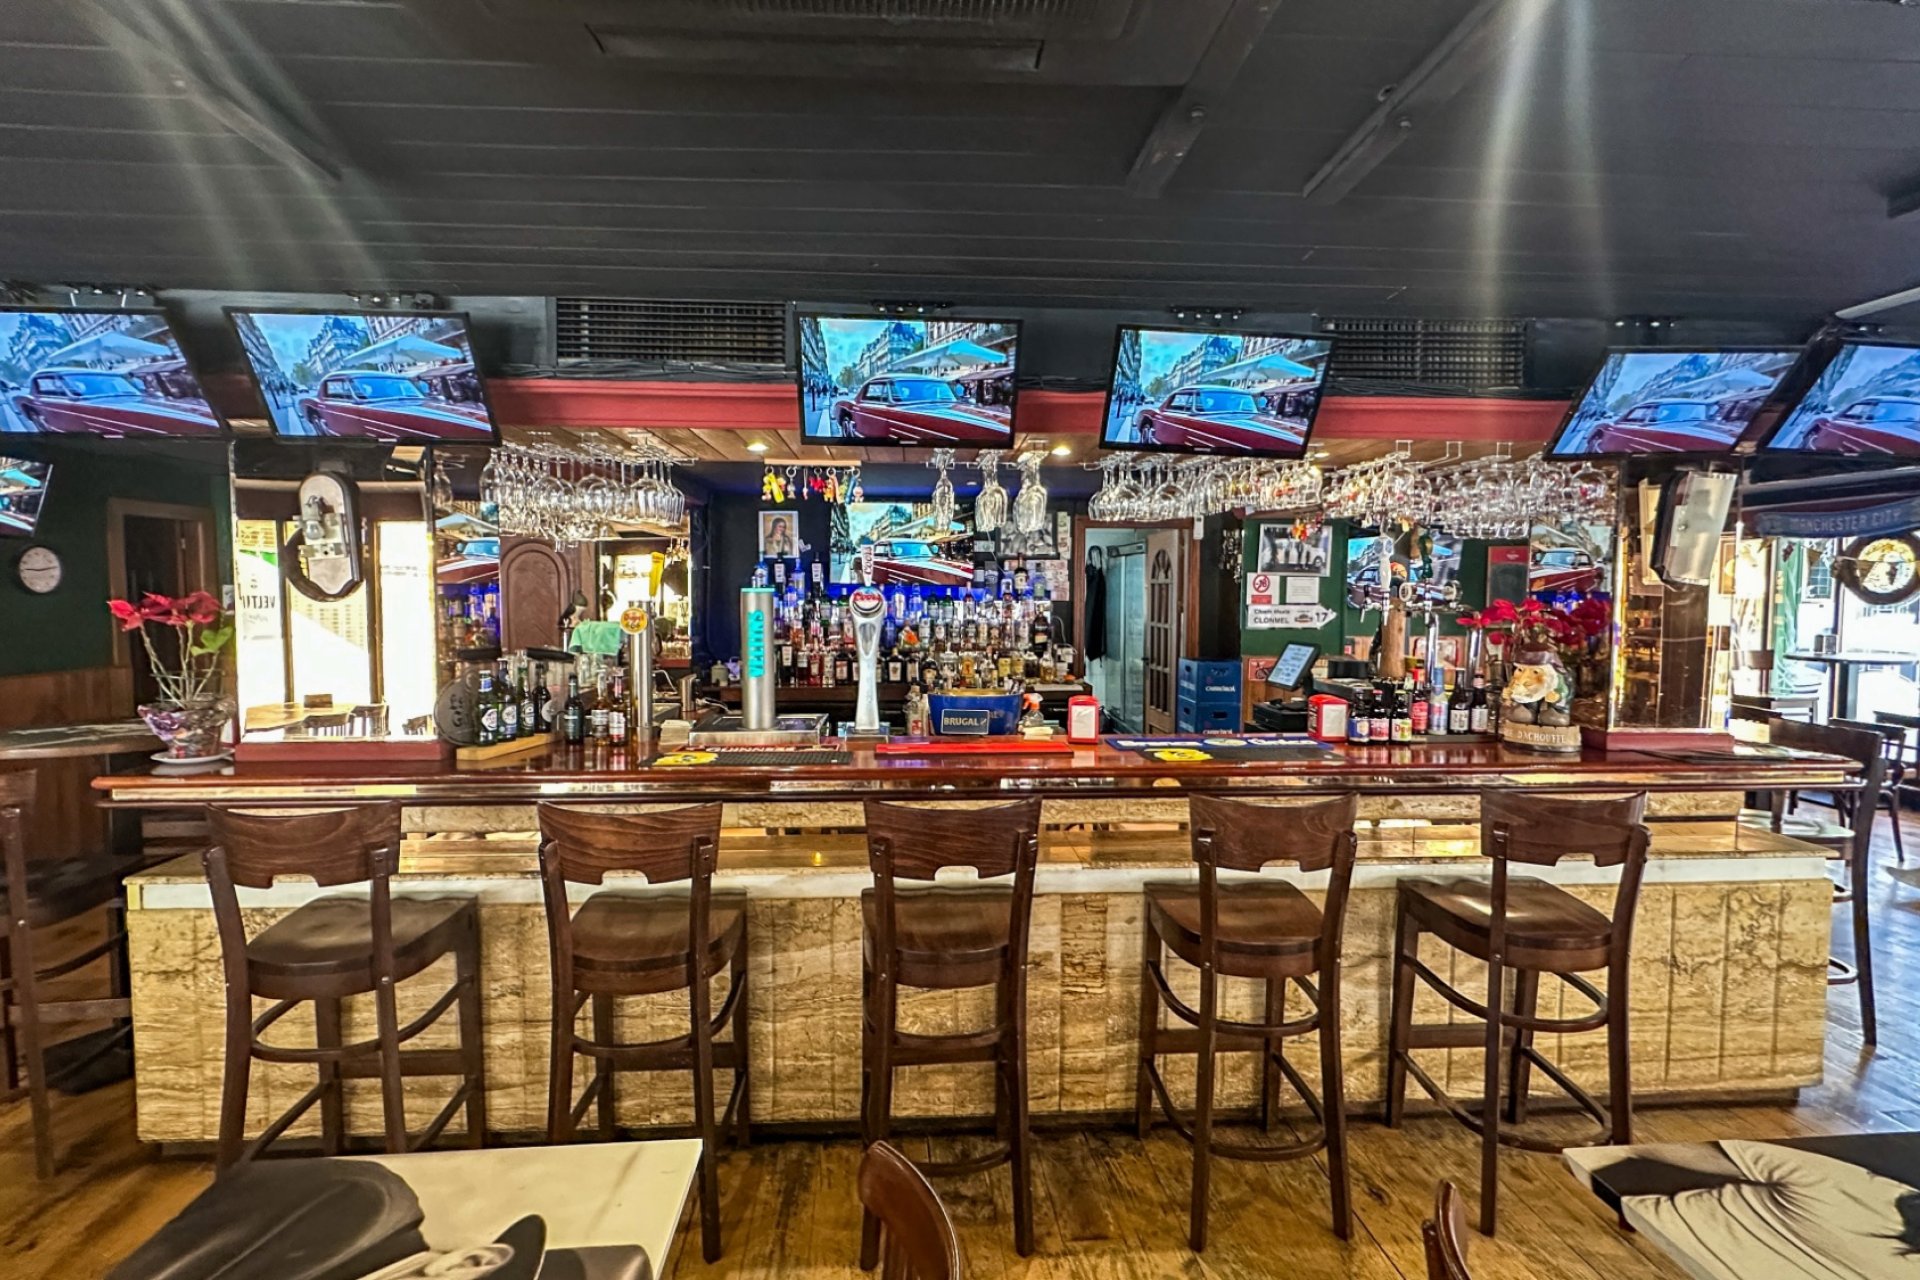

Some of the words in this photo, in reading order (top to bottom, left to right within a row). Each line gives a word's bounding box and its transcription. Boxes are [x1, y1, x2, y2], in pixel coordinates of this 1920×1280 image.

[1791, 514, 1867, 531] MANCHESTER
[1871, 509, 1901, 527] CITY
[1315, 612, 1329, 622] 17
[943, 717, 980, 726] BRUGAL
